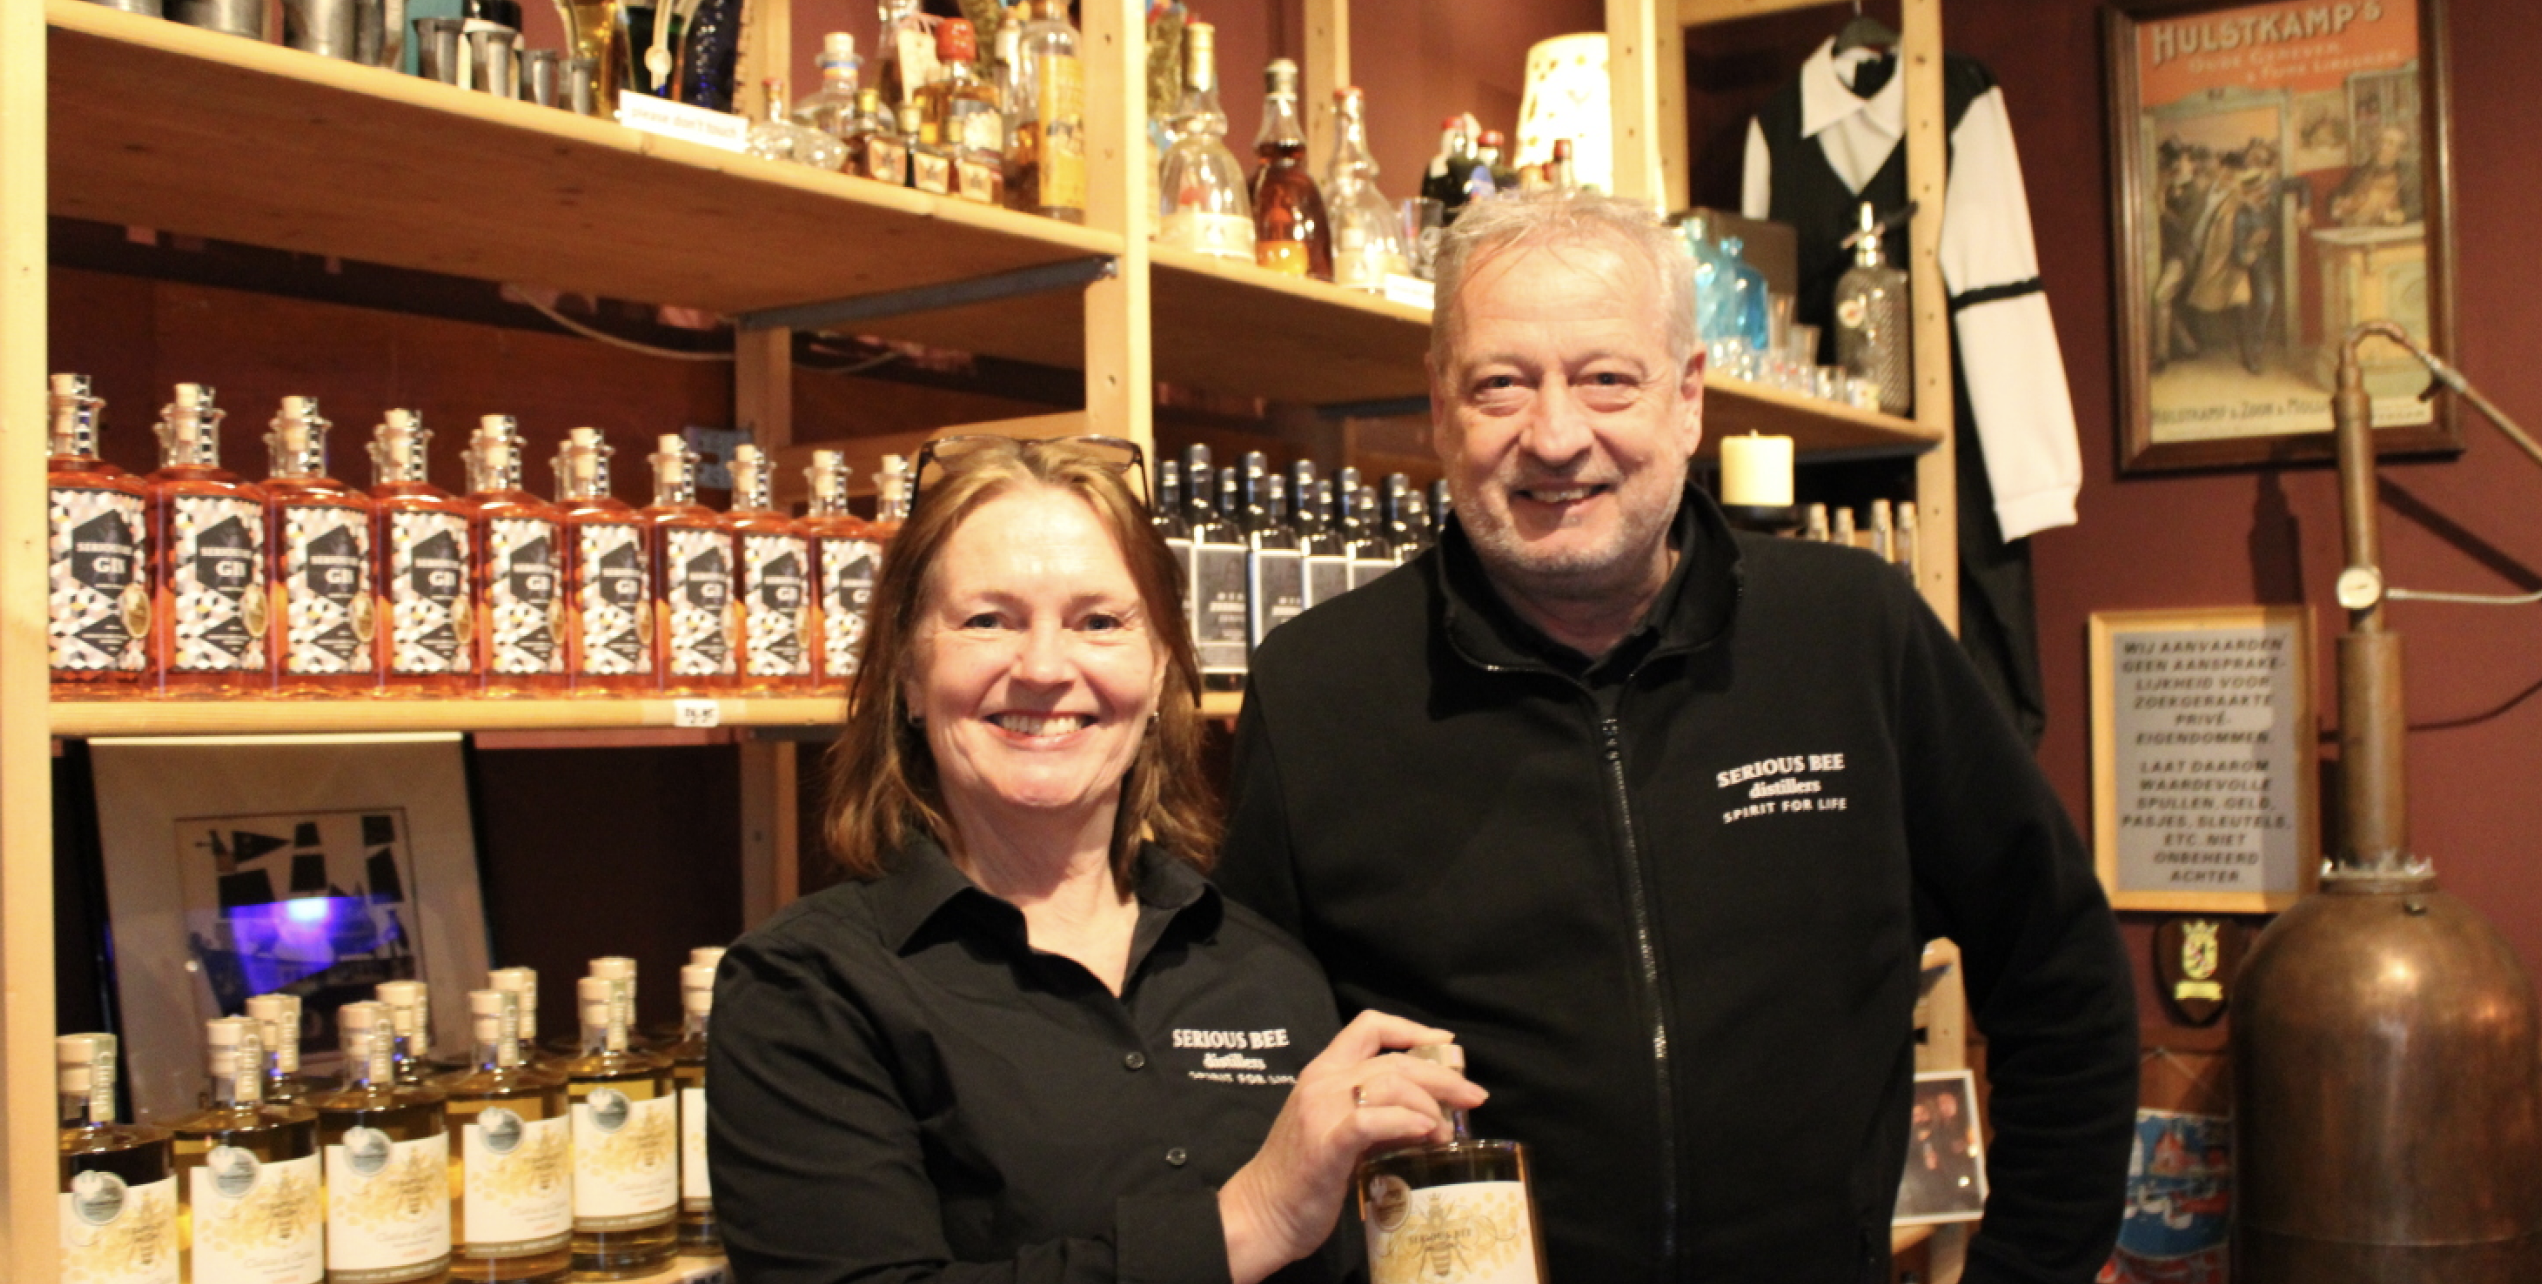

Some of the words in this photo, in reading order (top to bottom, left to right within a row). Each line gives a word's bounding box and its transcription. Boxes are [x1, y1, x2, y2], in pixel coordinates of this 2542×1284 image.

[2153, 0, 2382, 66] HULSTKAMP'S
[2124, 641, 2156, 654] WIJ
[2160, 638, 2283, 654] AANVAARDEN
[2122, 658, 2168, 673] GEEN
[2135, 676, 2213, 691] LIJKHEID
[2219, 676, 2271, 689] VOOR
[2134, 693, 2274, 709] ZOEKGERAAKTE
[1716, 754, 1806, 789] SERIOUS
[1808, 752, 1846, 773] BEE
[2139, 759, 2186, 773] LAAT
[2190, 758, 2271, 773] DAAROM
[1749, 776, 1823, 799] distillers
[2139, 777, 2272, 792] WAARDEVOLLE
[1722, 801, 1776, 824] SPIRIT
[1781, 798, 1813, 813] FOR
[1817, 796, 1848, 812] LIFE
[2206, 832, 2247, 846] NIET
[2152, 851, 2260, 866] ONBEHEERD
[1172, 1028, 1248, 1049] SERIOUS
[1248, 1028, 1290, 1050] BEE
